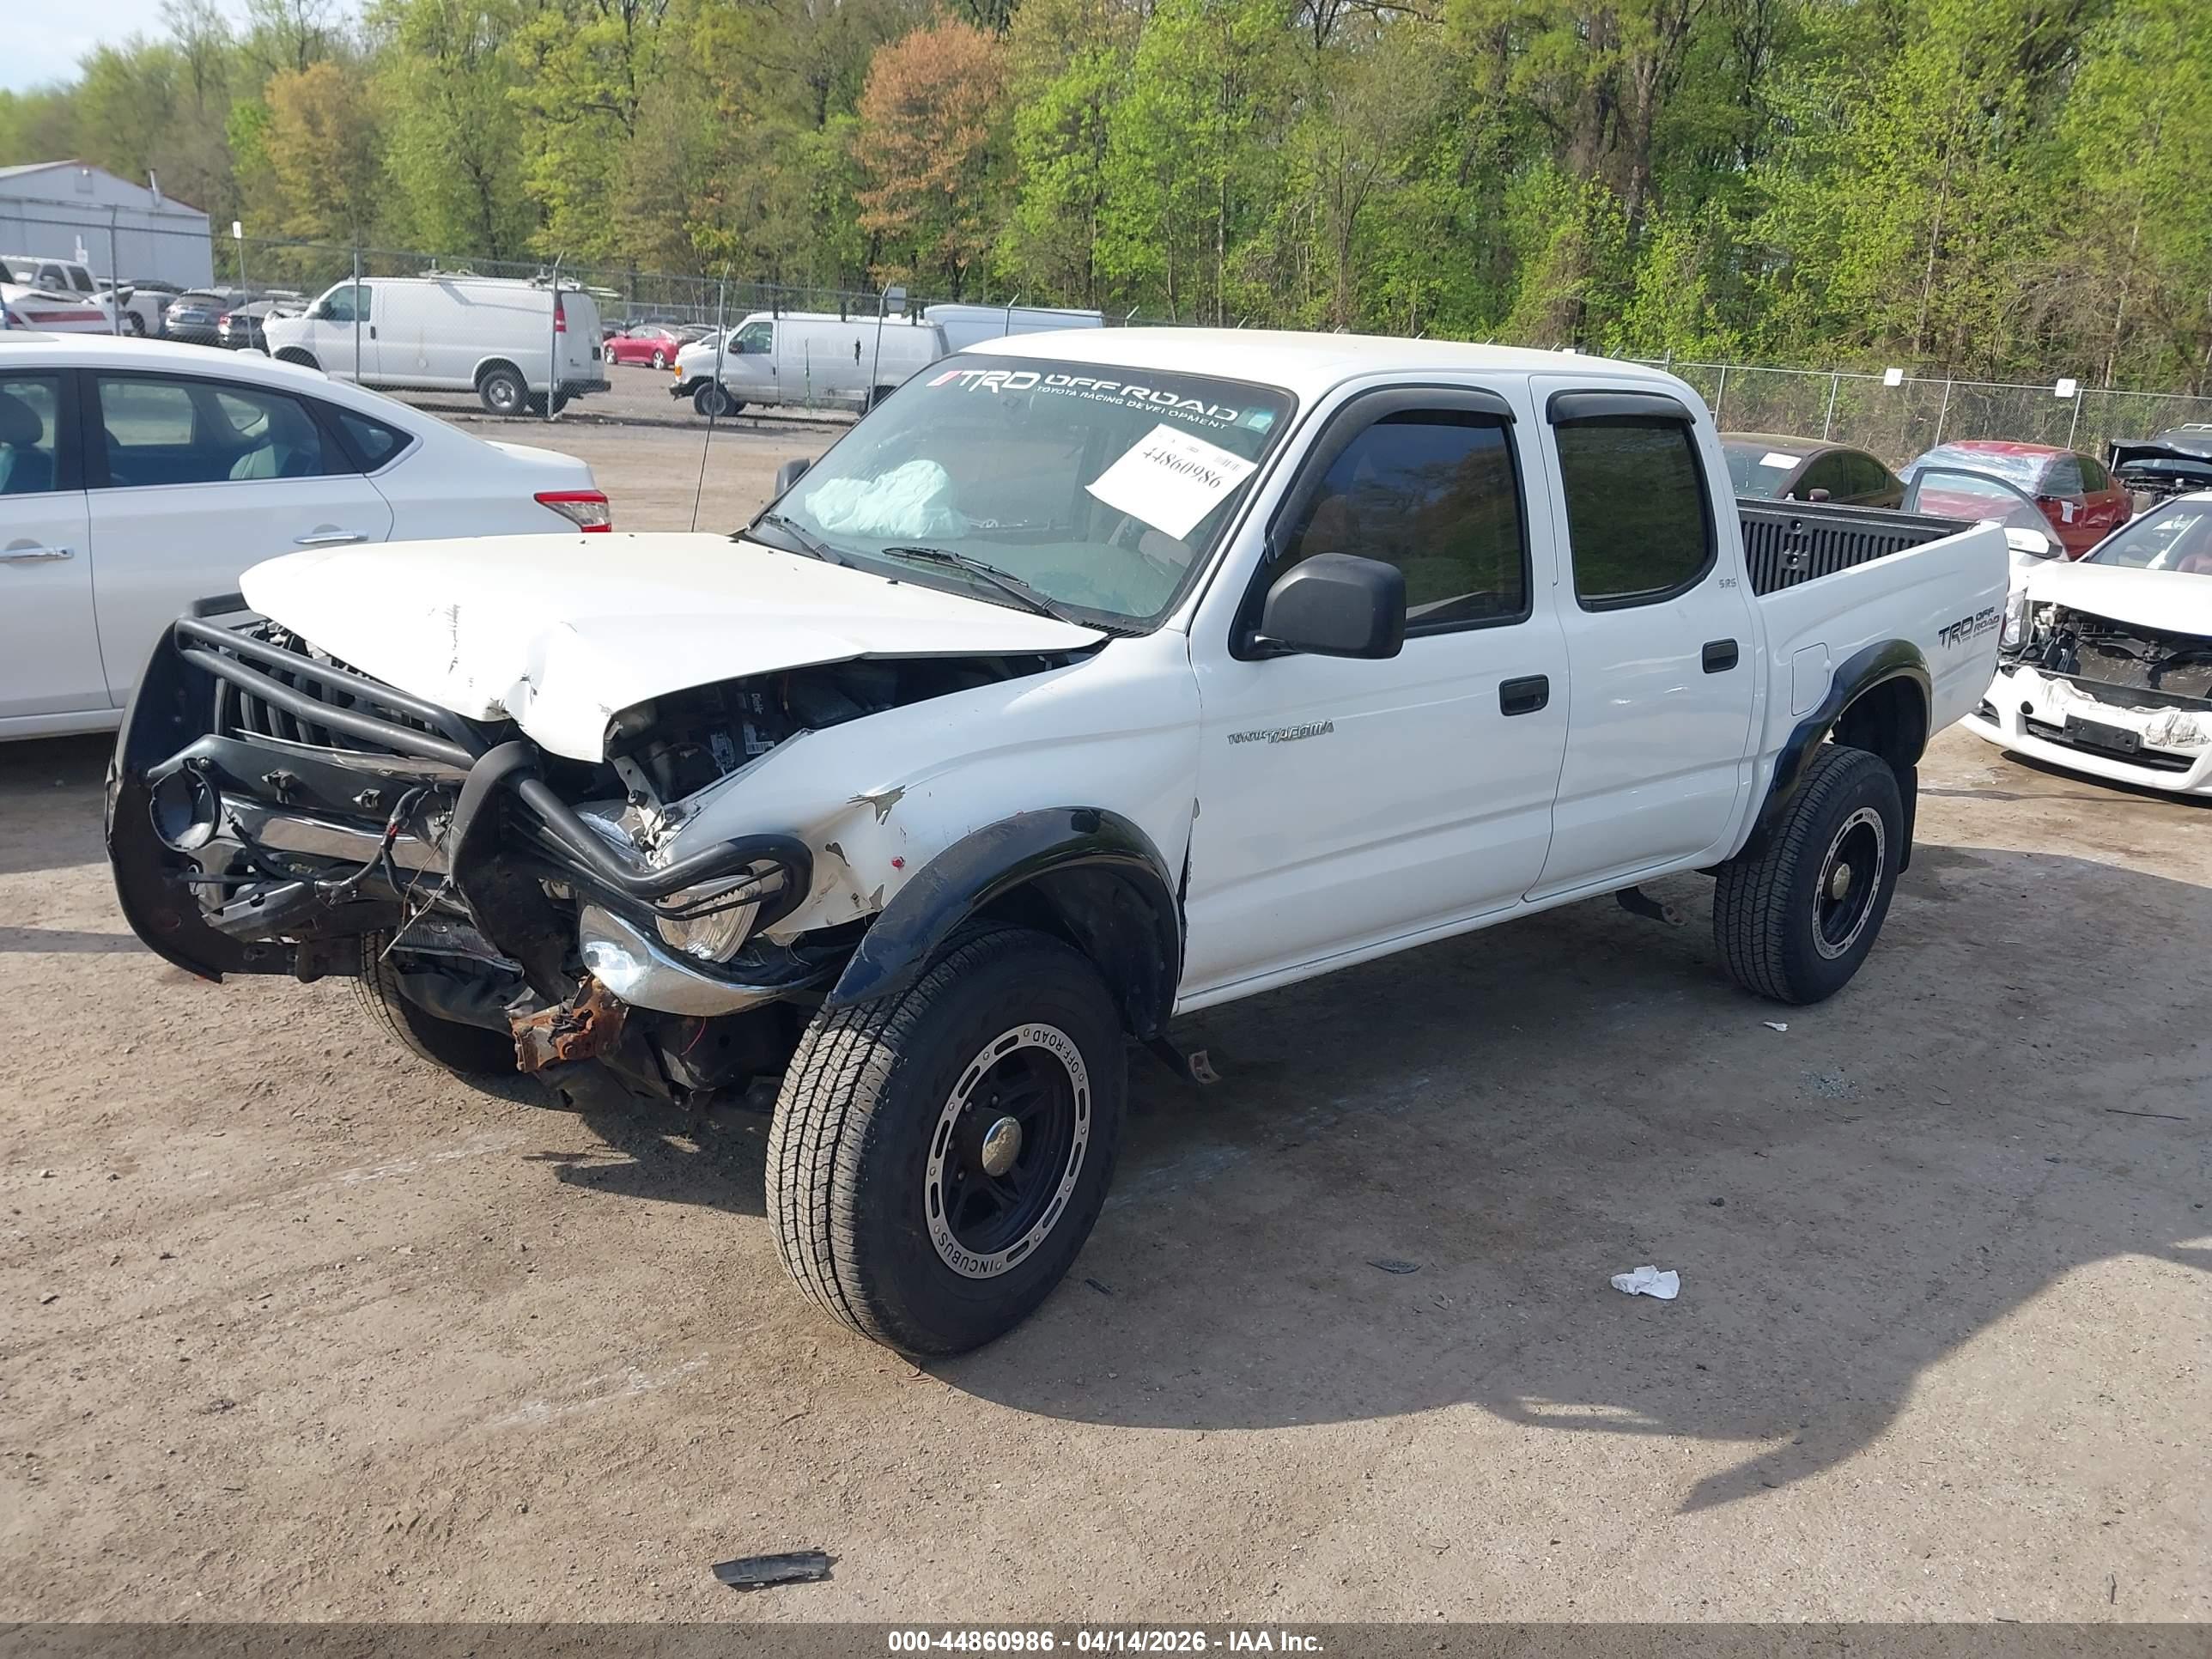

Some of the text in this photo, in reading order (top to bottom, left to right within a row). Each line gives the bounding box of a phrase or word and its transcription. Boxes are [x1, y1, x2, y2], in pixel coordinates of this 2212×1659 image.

[959, 370, 1238, 422] TRD OFF ROAD
[1036, 386, 1077, 397] TOYOTA
[1079, 392, 1125, 405] RACING
[1143, 447, 1224, 489] 44860986
[1974, 614, 2000, 633] ROAD
[1976, 606, 1995, 621] OFF
[1938, 616, 1973, 651] TRD
[1032, 1030, 1079, 1073] OFF-ROAD
[938, 1232, 994, 1273] INCUBUS
